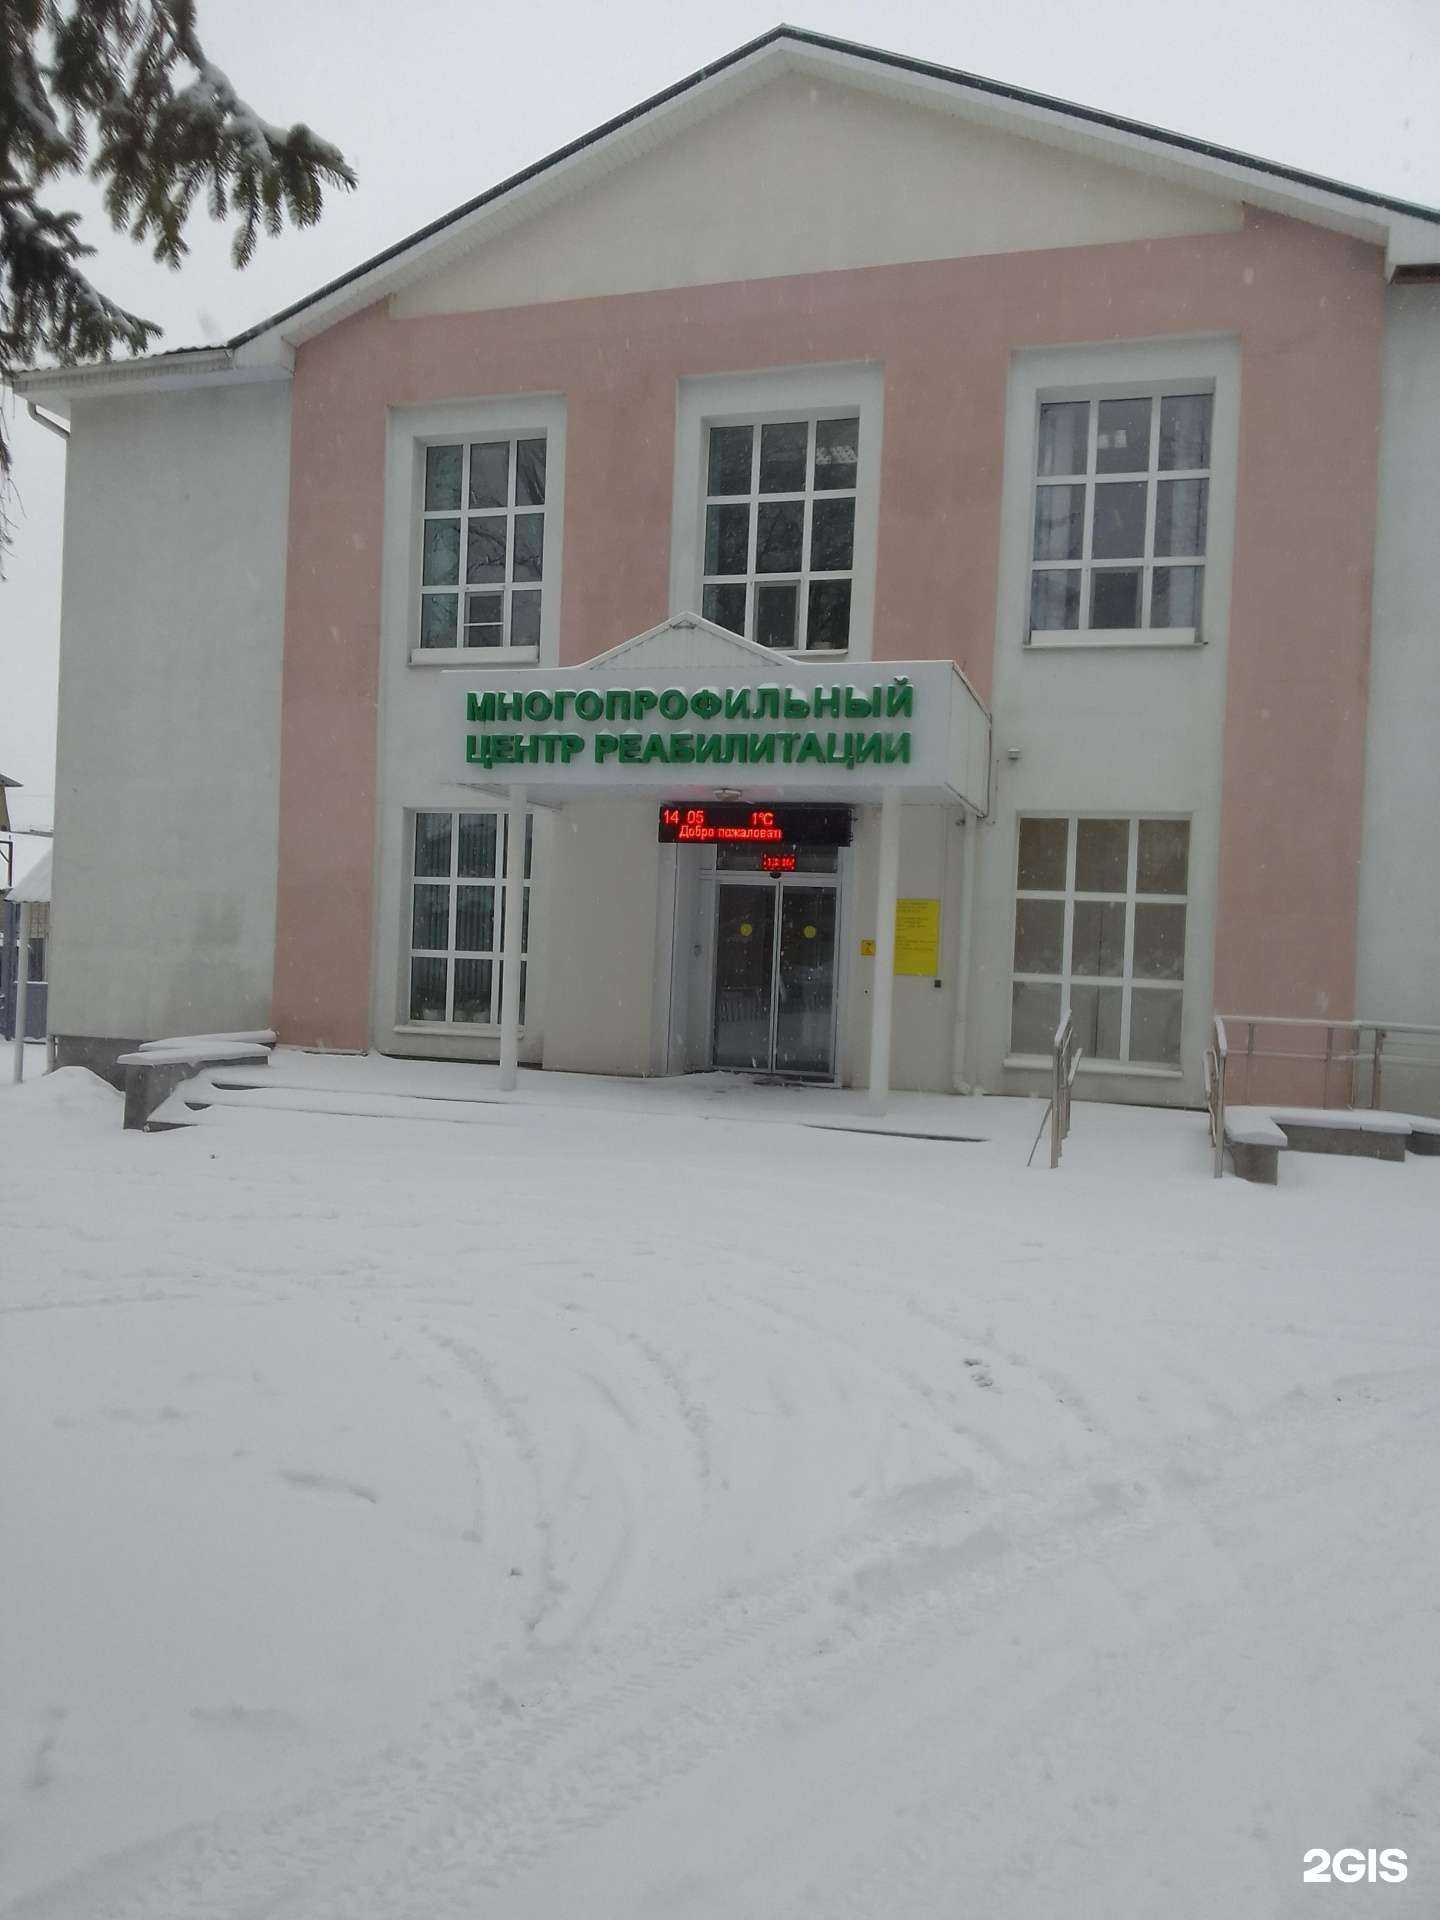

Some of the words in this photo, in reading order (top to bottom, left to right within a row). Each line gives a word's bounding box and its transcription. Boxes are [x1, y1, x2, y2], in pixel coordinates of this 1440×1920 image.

[467, 677, 913, 721] МНОГОПРОФИЛЬНЫЙ
[466, 733, 585, 769] ЦЕНТР
[595, 731, 911, 769] РЕАБИЛИТАЦИИ
[664, 810, 679, 824] 14
[687, 810, 704, 824] 05
[679, 825, 714, 840] Добро
